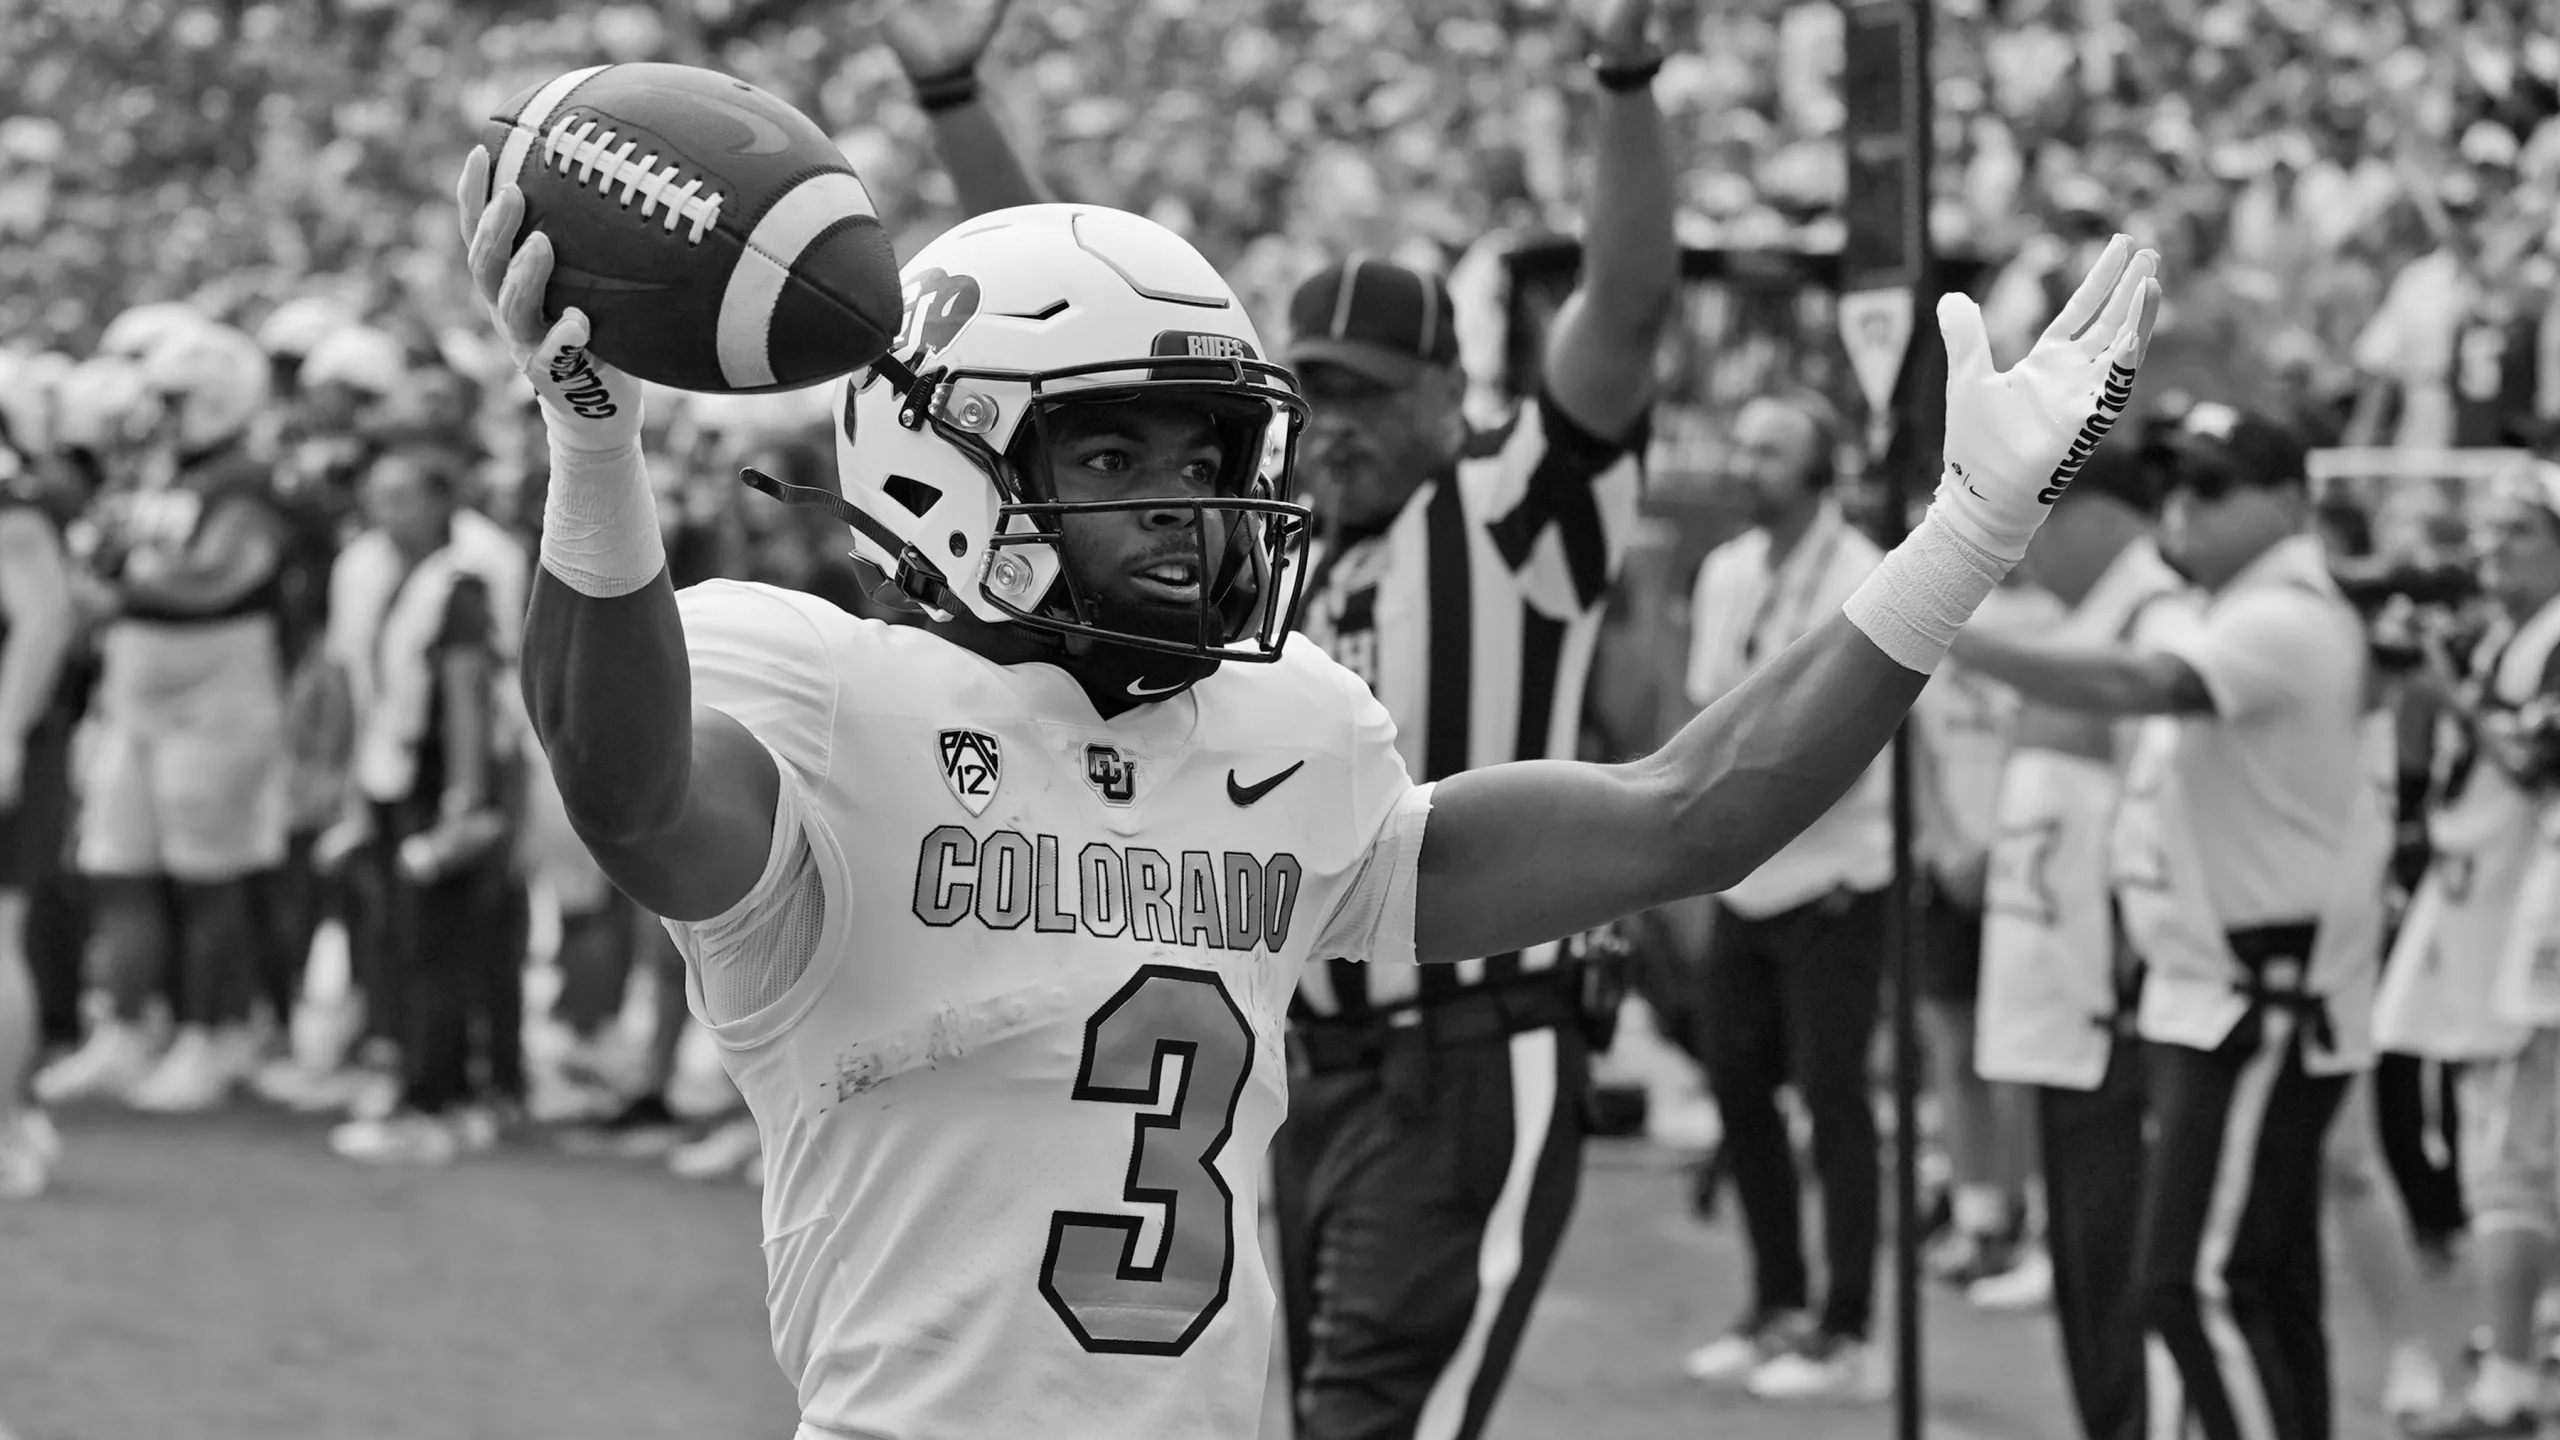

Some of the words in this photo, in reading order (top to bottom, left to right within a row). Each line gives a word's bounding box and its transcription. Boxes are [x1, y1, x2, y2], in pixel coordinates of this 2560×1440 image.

[1186, 335, 1245, 359] BUFFS
[940, 731, 998, 781] PAC
[957, 764, 991, 795] 12
[912, 825, 1302, 953] COLORADO
[1038, 964, 1256, 1357] 3
